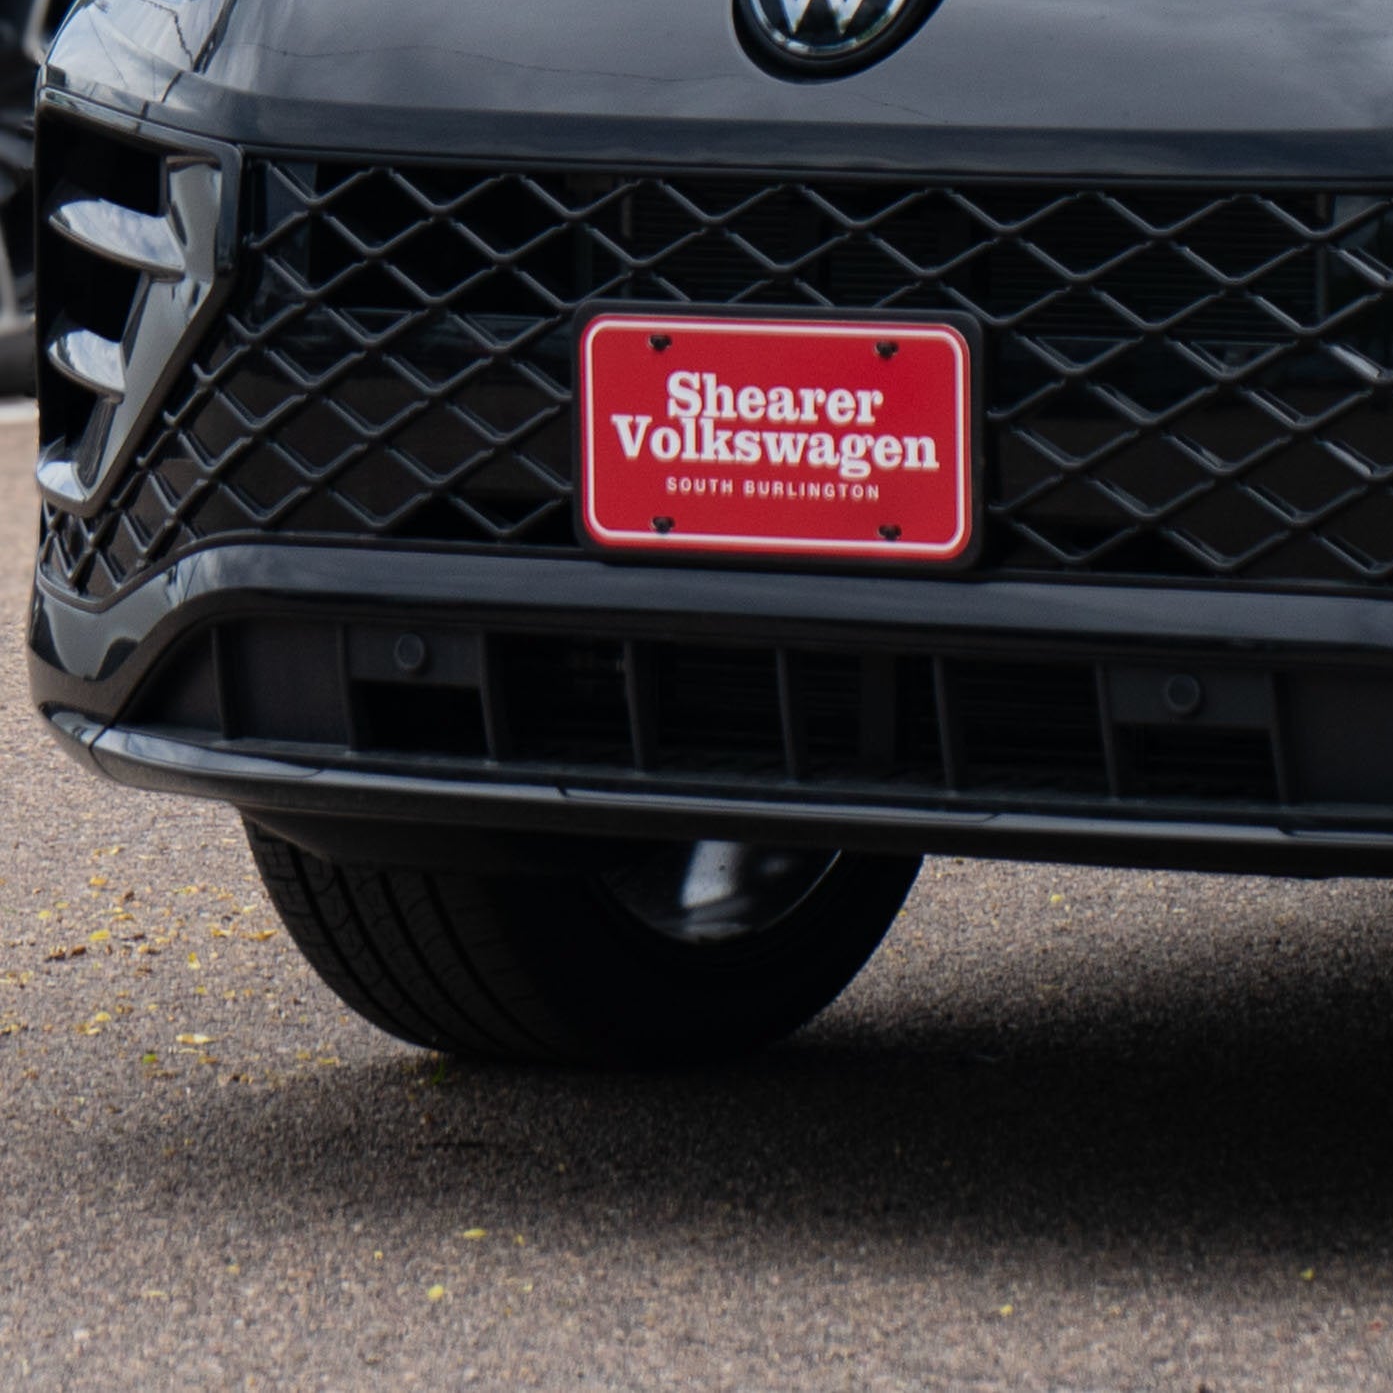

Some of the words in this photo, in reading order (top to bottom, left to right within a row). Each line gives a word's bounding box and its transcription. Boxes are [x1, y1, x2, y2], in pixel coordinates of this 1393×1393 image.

[666, 370, 883, 425] Shearer
[610, 414, 940, 479] Volkswagen
[665, 476, 734, 496] SOUTH
[743, 479, 881, 501] BURLINGTON
